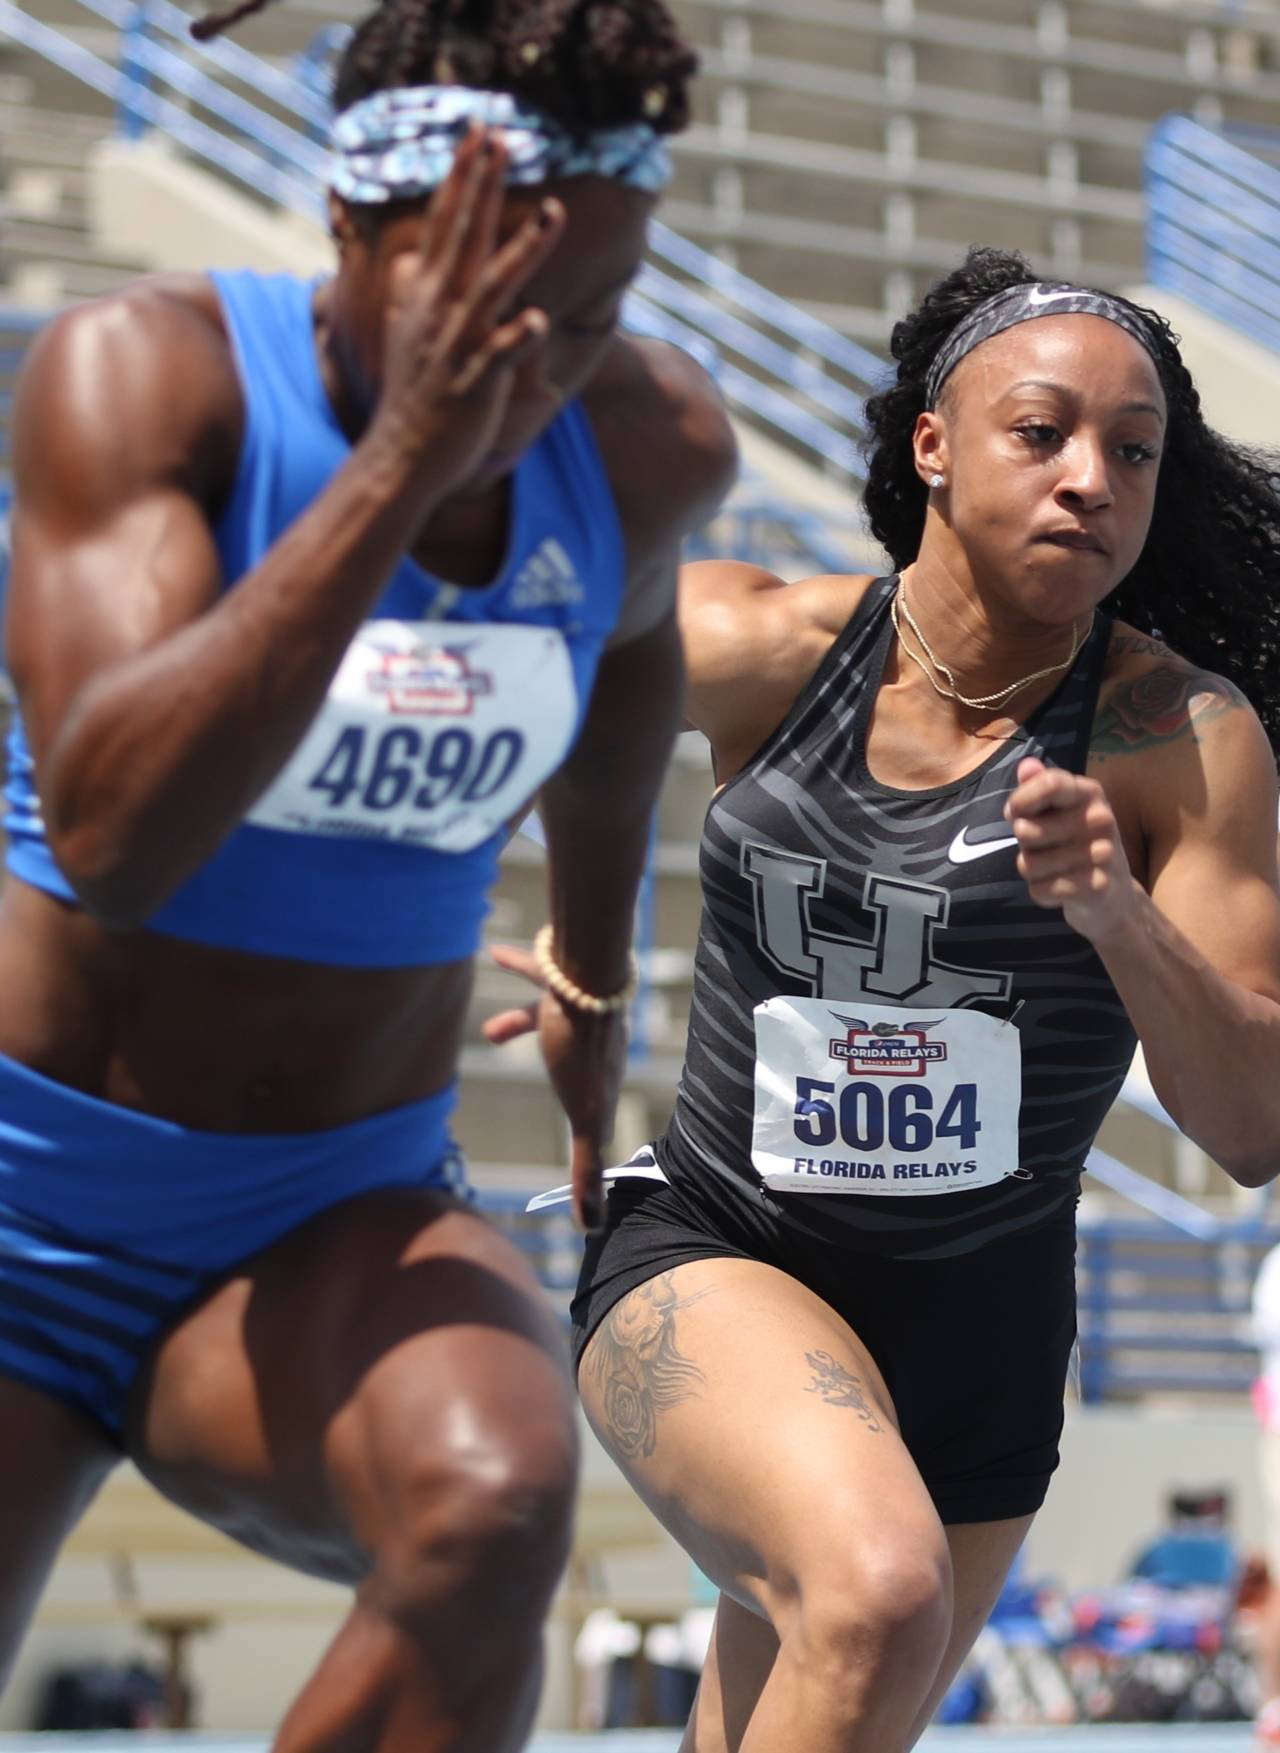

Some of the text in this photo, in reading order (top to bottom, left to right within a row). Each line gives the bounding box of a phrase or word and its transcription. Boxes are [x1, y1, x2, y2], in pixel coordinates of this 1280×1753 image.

[307, 725, 526, 811] 4690
[837, 1046, 938, 1058] FLORIDA RELAYS
[794, 1076, 981, 1152] 5064
[793, 1157, 977, 1180] FLORIDA RELAYS
